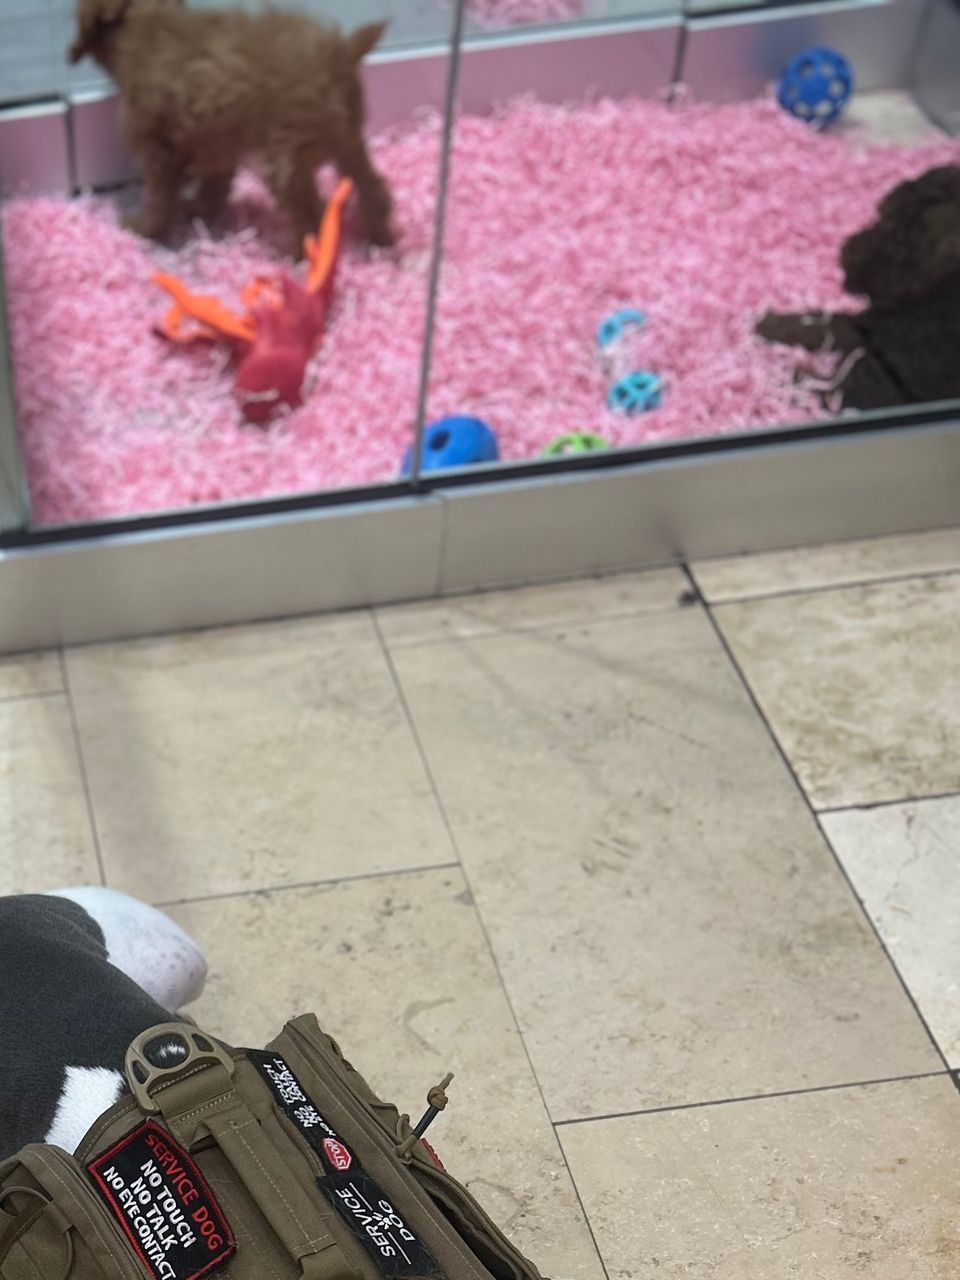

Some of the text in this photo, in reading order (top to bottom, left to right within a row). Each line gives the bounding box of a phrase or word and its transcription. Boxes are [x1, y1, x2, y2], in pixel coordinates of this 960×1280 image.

[263, 1064, 313, 1128] NO TOUCH
[320, 1122, 336, 1136] NO
[328, 1141, 347, 1168] STOP
[103, 1166, 177, 1280] NO EYE CONTACT
[130, 1176, 178, 1251] NO TALK
[140, 1159, 197, 1248] NO TOUCH
[144, 1134, 223, 1250] SERVICE DOG
[335, 1188, 396, 1257] SERVICE
[378, 1199, 416, 1241] DOG
